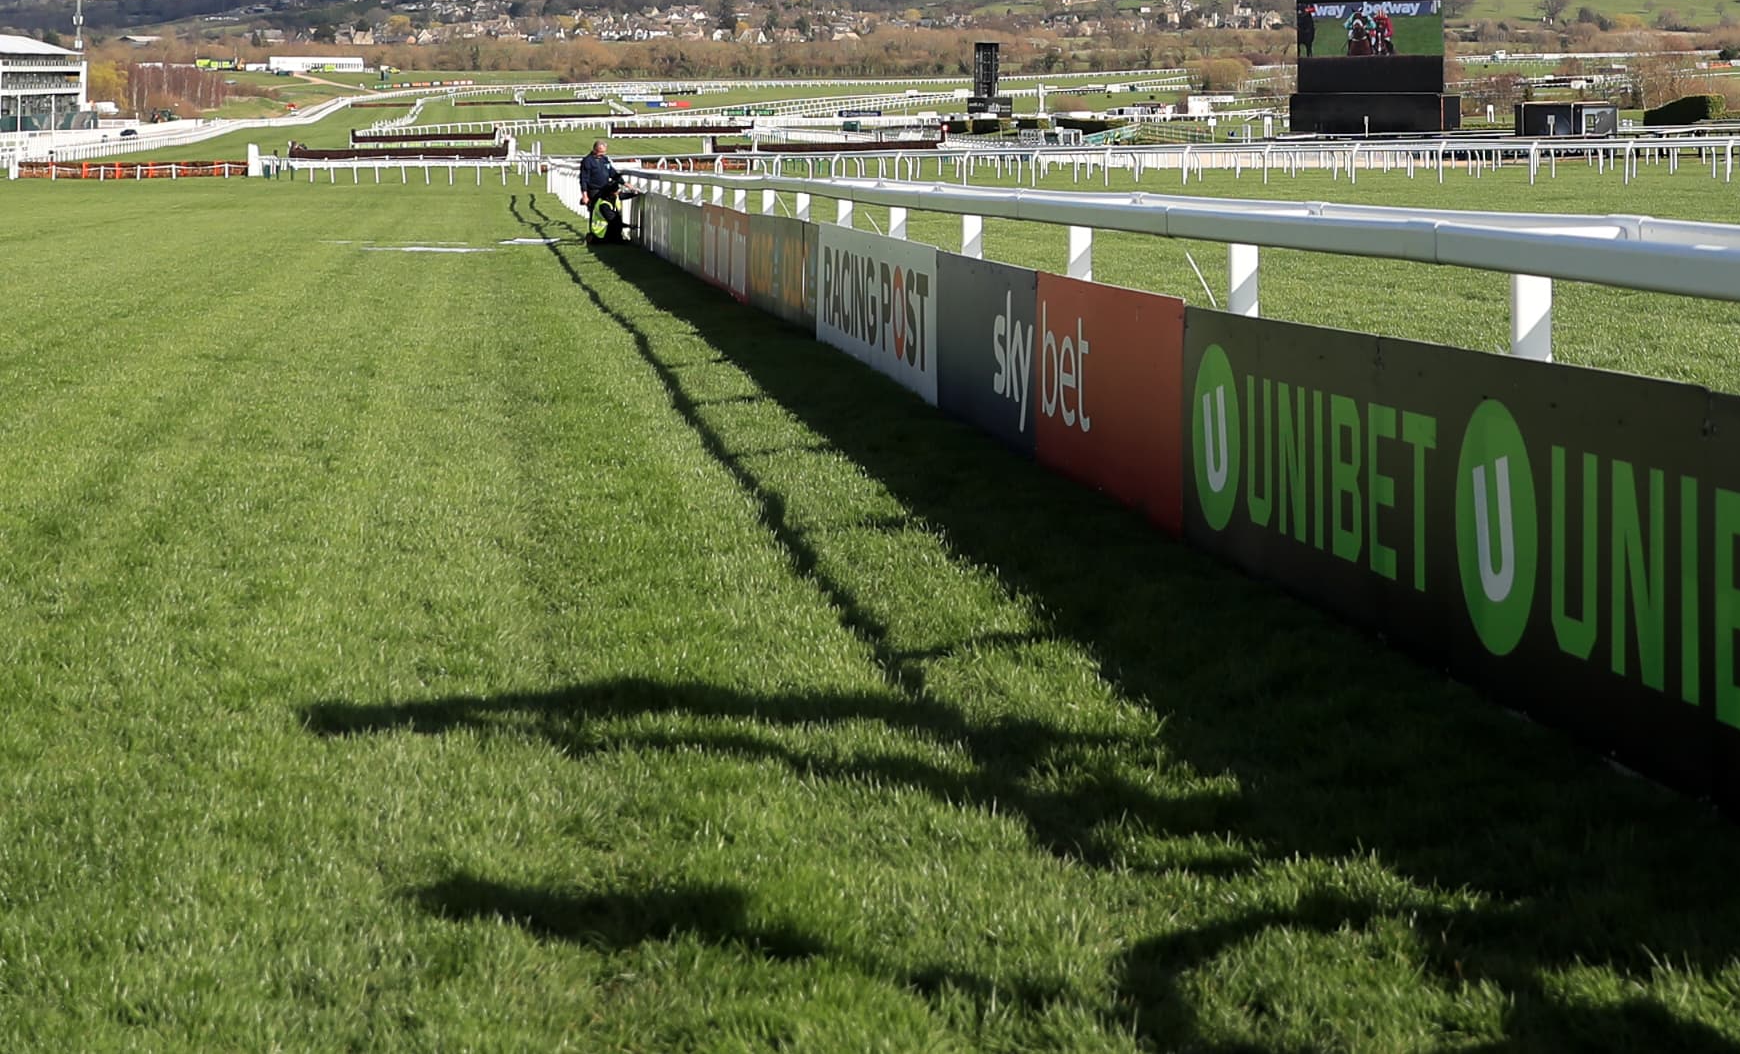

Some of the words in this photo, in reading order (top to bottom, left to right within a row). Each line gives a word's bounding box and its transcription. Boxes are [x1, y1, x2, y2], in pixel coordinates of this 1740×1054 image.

[1363, 1, 1420, 16] betway
[823, 245, 877, 346] RACING
[880, 262, 929, 372] POST
[993, 290, 1033, 433] sky
[1042, 300, 1090, 432] bet
[1202, 384, 1228, 493] U
[1246, 374, 1437, 592] UNIBET
[1472, 455, 1516, 603] U
